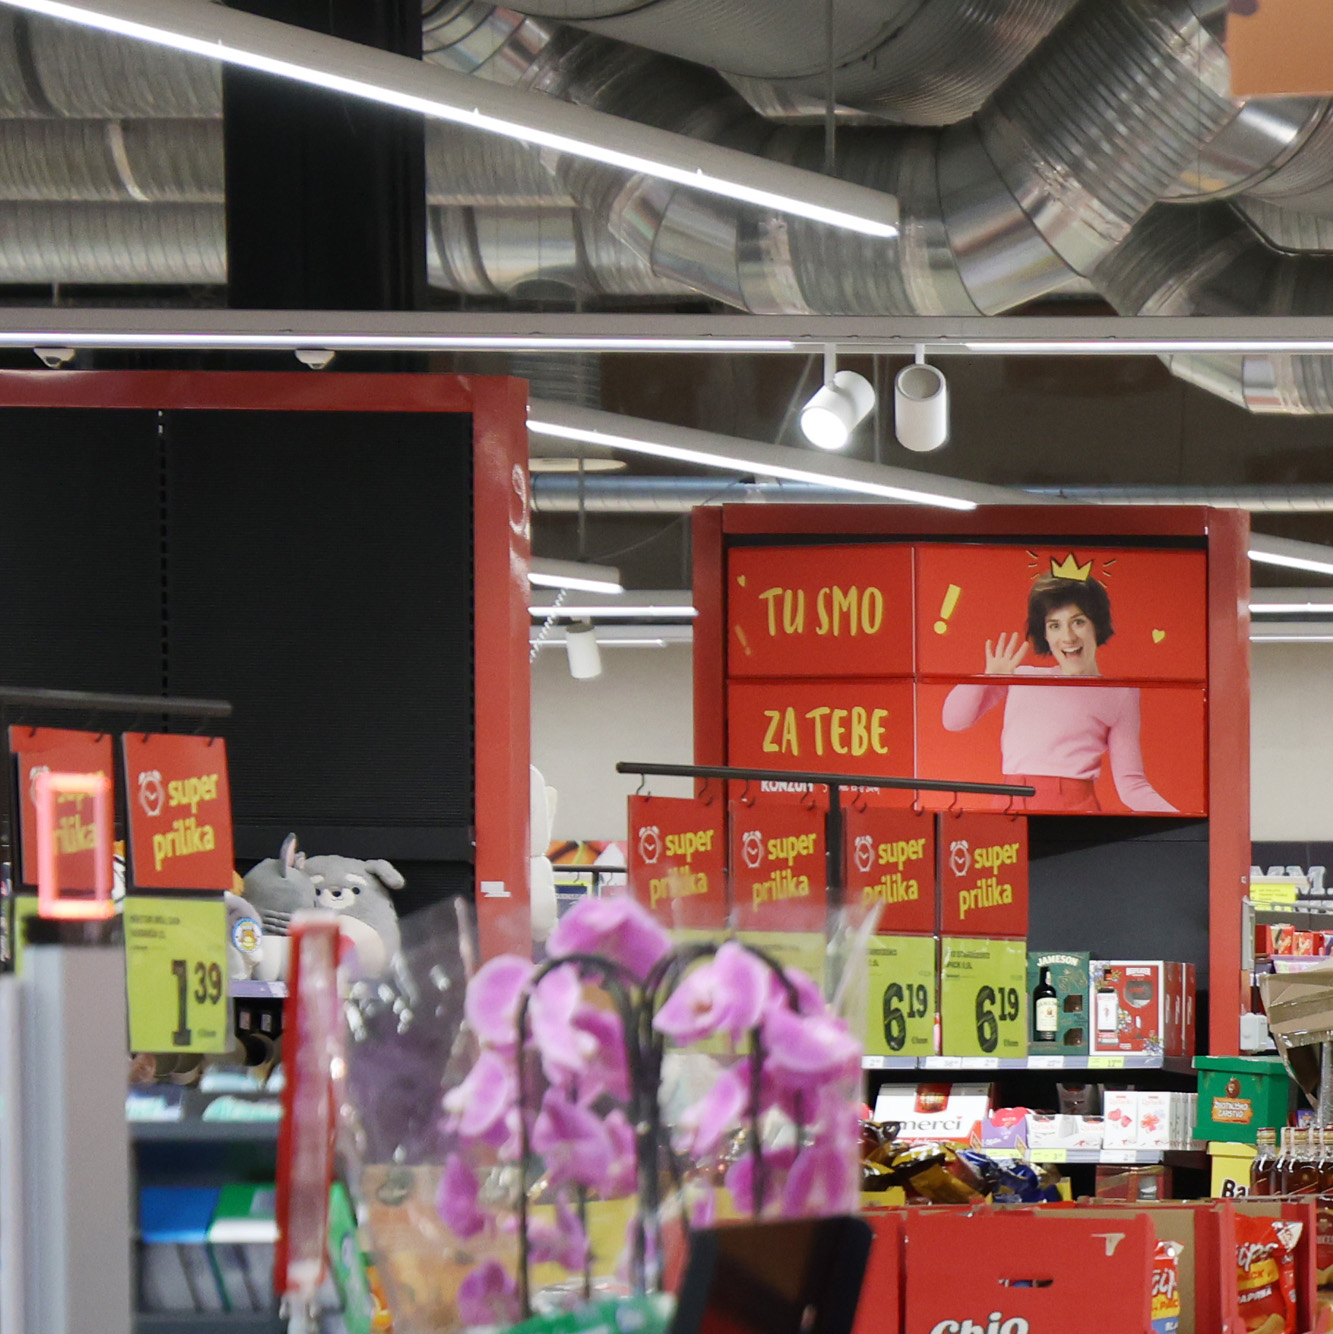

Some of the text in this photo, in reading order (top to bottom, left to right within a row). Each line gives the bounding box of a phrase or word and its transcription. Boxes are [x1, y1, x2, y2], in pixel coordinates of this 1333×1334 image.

[759, 585, 804, 637] TU
[816, 584, 884, 637] SMO
[762, 705, 889, 756] ZA TEBE
[168, 773, 219, 815] super
[152, 816, 216, 872] prilika
[665, 829, 714, 863] super
[768, 833, 817, 866] super
[878, 836, 927, 870] super
[974, 840, 1019, 877] super
[649, 864, 708, 909] prilika
[752, 868, 810, 912] prilika
[862, 872, 919, 907] prilika
[958, 878, 1014, 920] prilika
[1036, 954, 1080, 968] JAMESON
[171, 960, 222, 1047] 1 39
[883, 982, 928, 1052] 6 19
[975, 985, 1020, 1053] 6 19
[899, 1115, 963, 1131] merci
